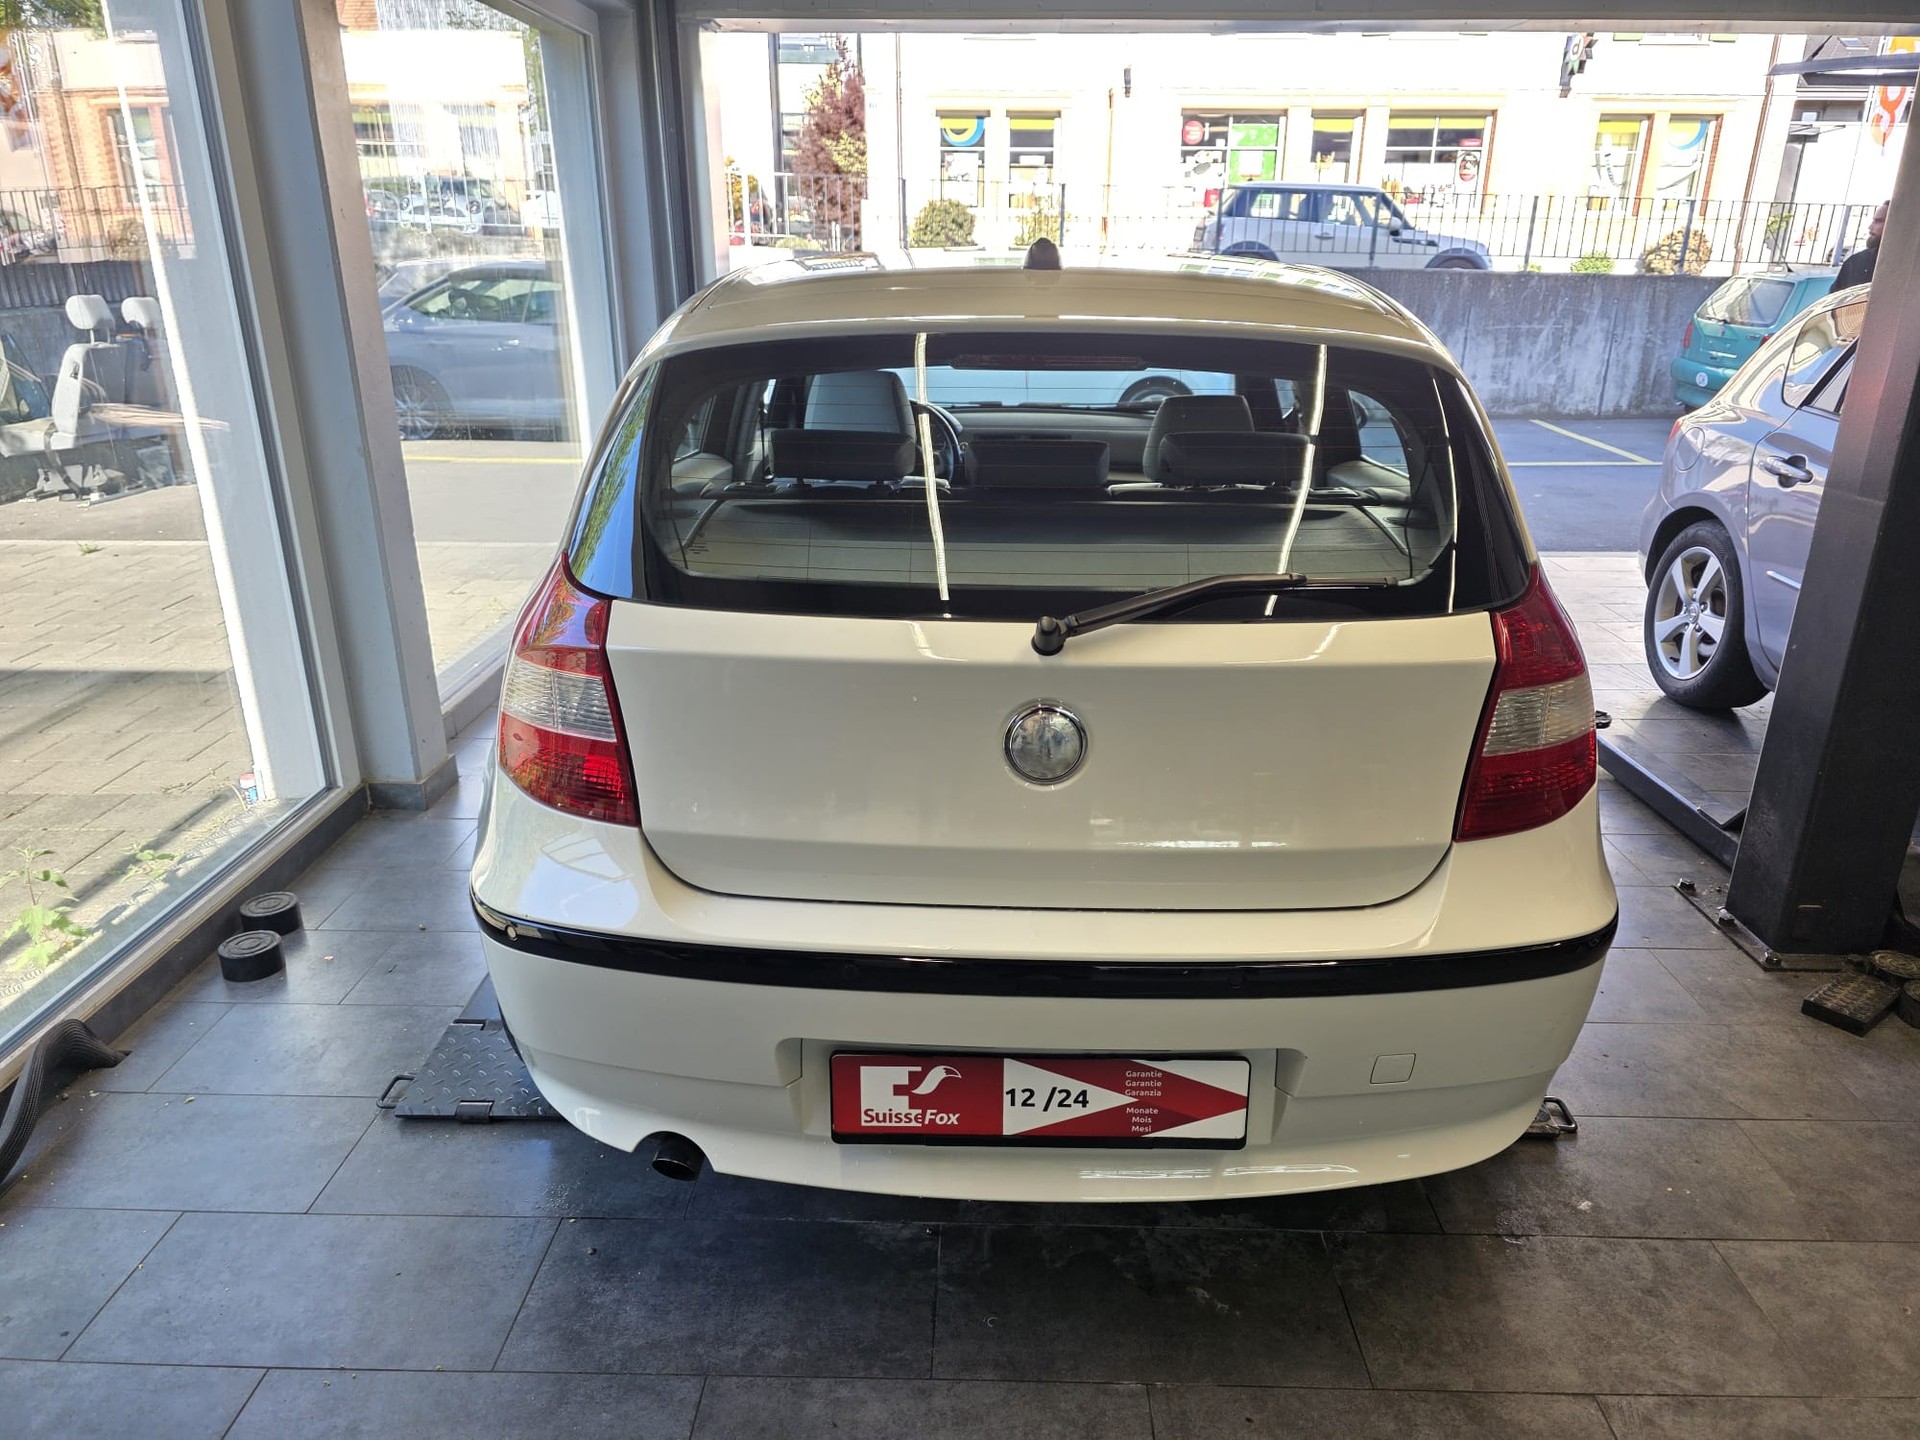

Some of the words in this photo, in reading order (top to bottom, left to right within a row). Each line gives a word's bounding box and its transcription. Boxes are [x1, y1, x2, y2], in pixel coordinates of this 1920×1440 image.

[1125, 1070, 1163, 1078] Garantie
[1125, 1079, 1162, 1087] Garantie
[1124, 1089, 1162, 1097] Garanzia
[1005, 1088, 1036, 1107] 12
[1042, 1086, 1090, 1112] /24
[1126, 1107, 1159, 1115] Monate
